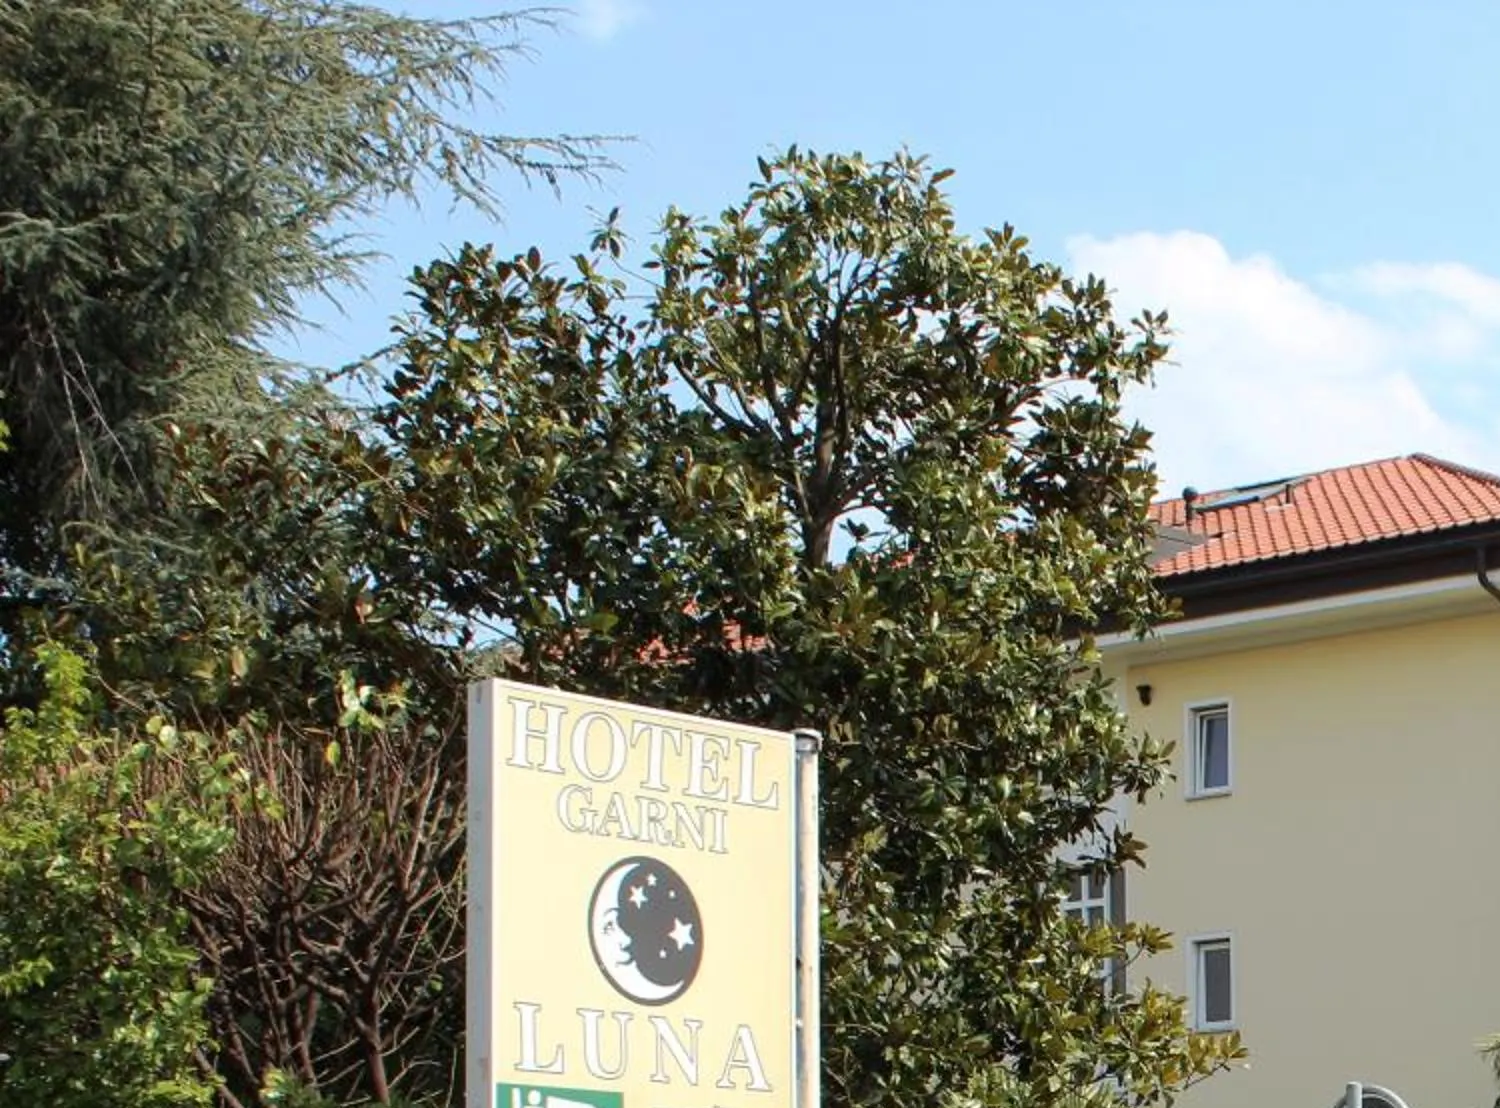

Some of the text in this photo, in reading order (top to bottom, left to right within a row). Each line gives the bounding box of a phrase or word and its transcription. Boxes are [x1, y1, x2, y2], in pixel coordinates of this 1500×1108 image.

[507, 697, 779, 810] HOTEL
[557, 783, 728, 854] GARNI
[513, 1001, 774, 1093] LUNA
